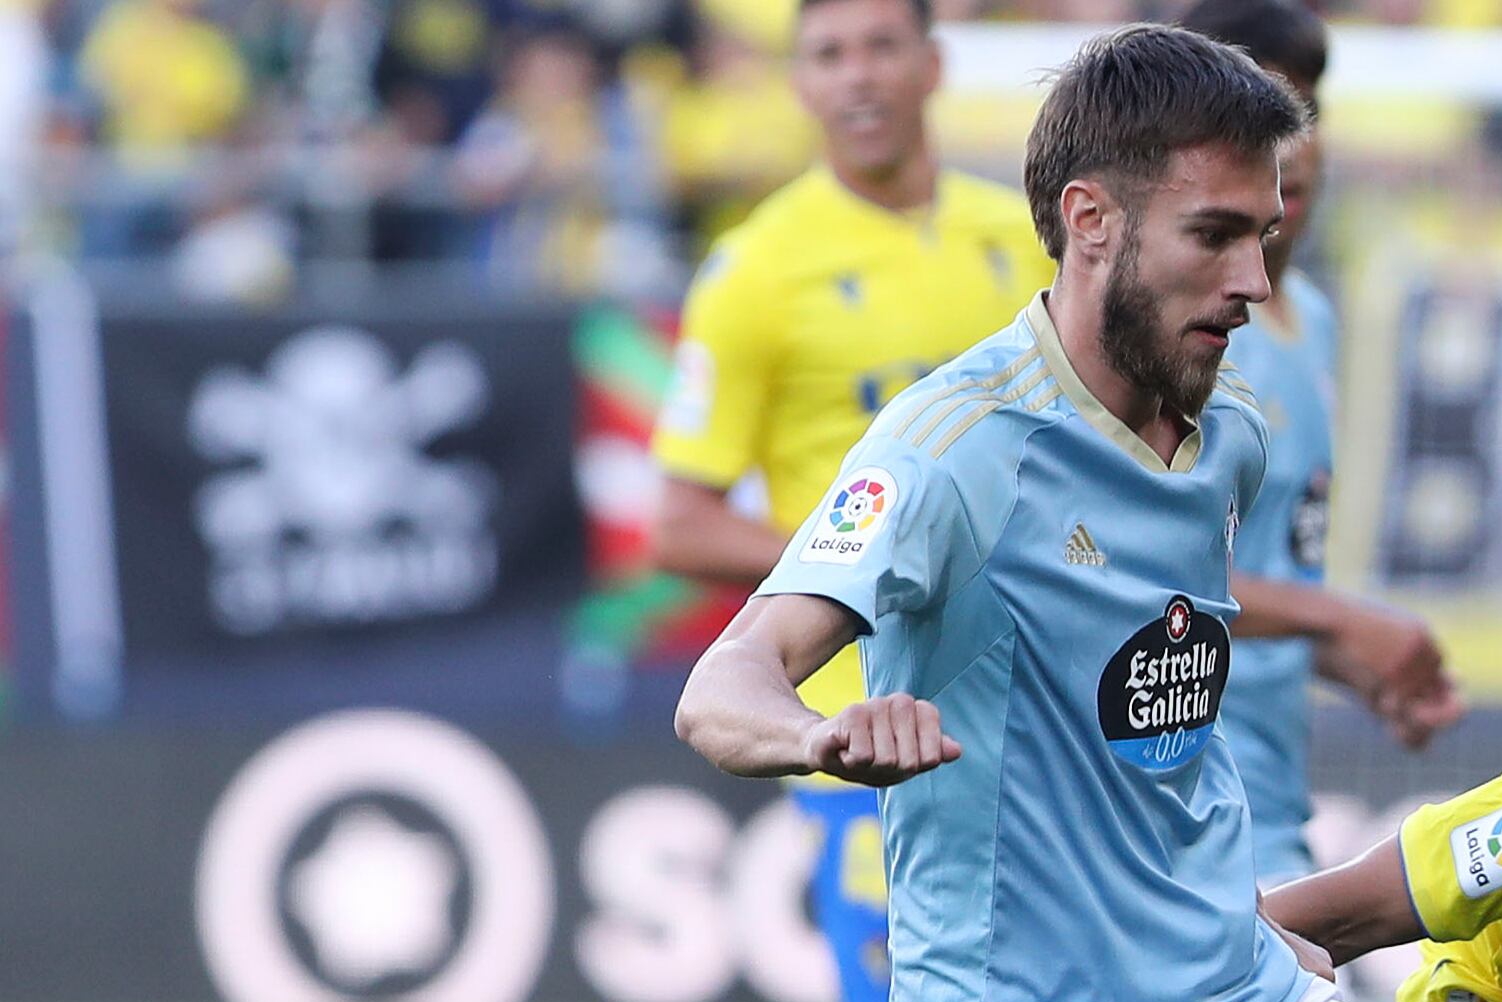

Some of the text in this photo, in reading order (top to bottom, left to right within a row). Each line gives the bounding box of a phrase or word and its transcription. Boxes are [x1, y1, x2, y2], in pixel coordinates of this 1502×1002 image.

[811, 537, 863, 554] LaLiga
[1125, 642, 1217, 689] Estrella
[1128, 681, 1209, 730] Galicia
[1466, 827, 1490, 887] LaLiga
